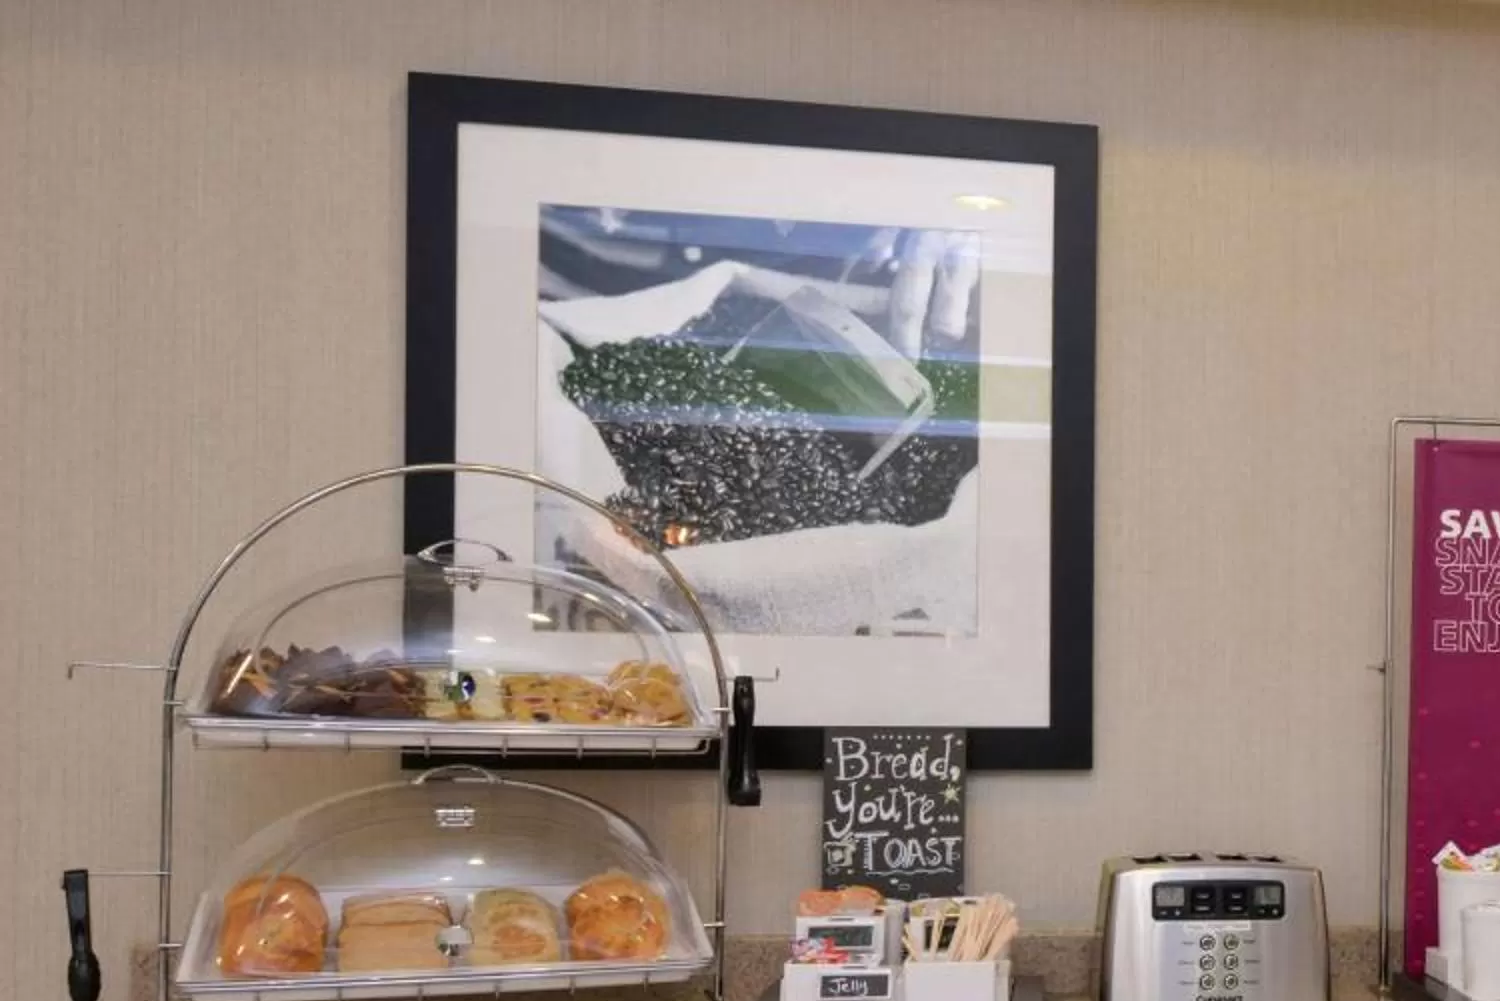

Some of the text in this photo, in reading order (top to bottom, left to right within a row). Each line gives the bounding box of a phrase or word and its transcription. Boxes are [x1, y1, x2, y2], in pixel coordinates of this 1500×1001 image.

[831, 733, 961, 782] Bread,
[853, 831, 962, 871] TOAST
[828, 977, 869, 996] Jelly
